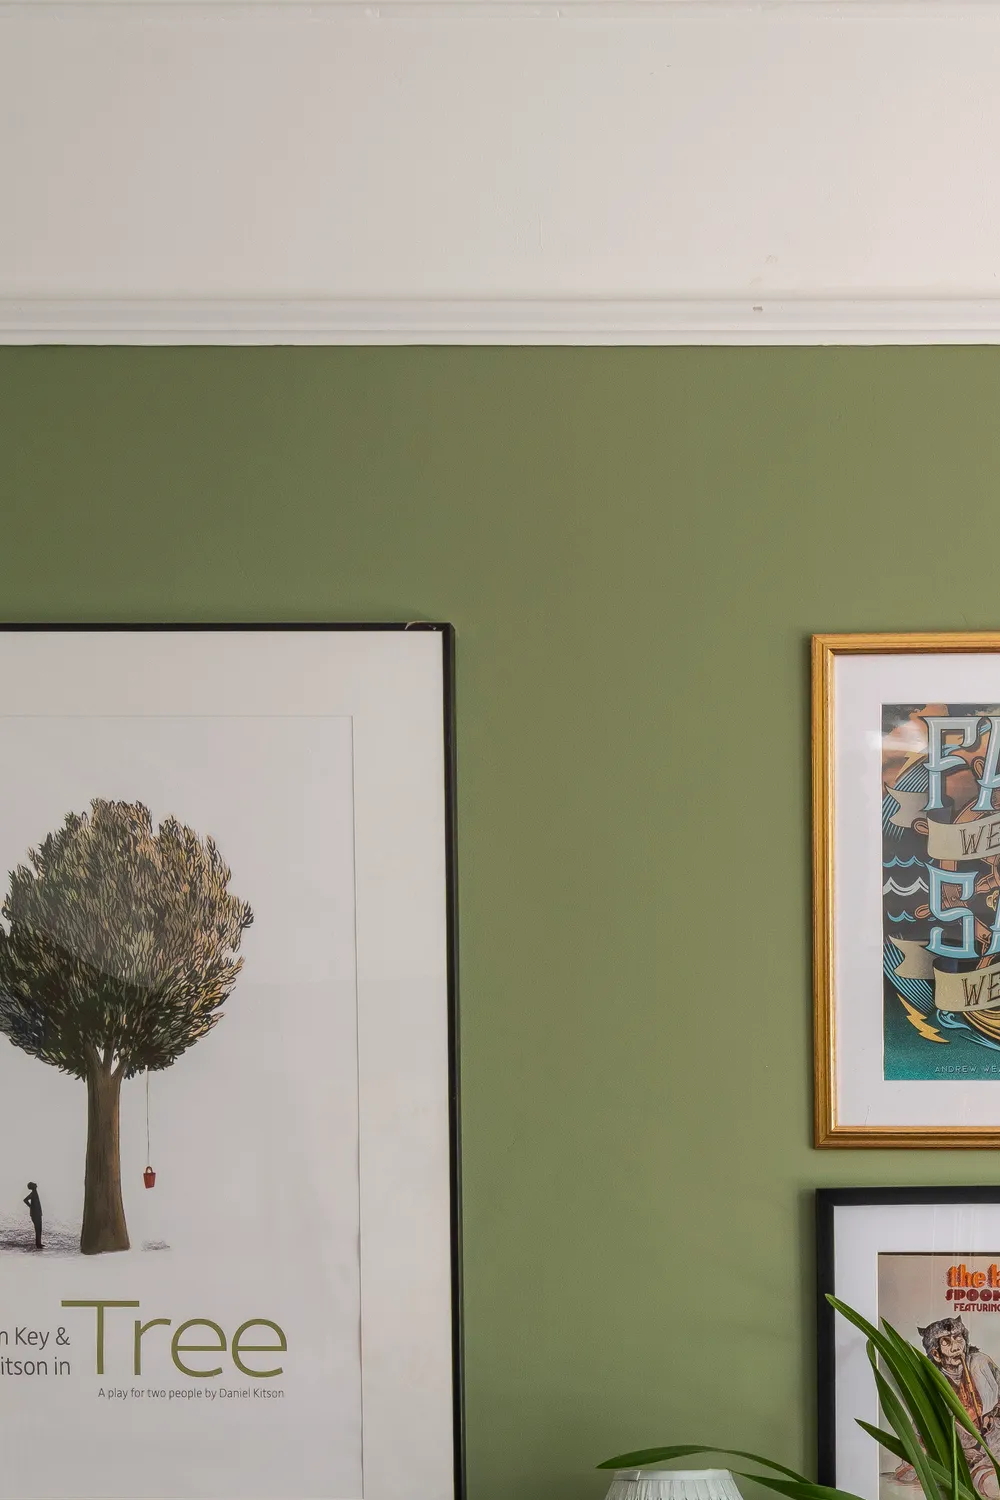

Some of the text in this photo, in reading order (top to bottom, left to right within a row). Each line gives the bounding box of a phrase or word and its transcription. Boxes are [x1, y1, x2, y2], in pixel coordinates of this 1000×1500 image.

[934, 1065, 978, 1074] ANDREW
[947, 1263, 987, 1289] the
[15, 1326, 50, 1351] Key
[55, 1326, 71, 1346] &
[61, 1299, 288, 1378] Tree
[54, 1356, 71, 1376] in
[97, 1387, 285, 1401] A play for two people by Daniel Kitson
